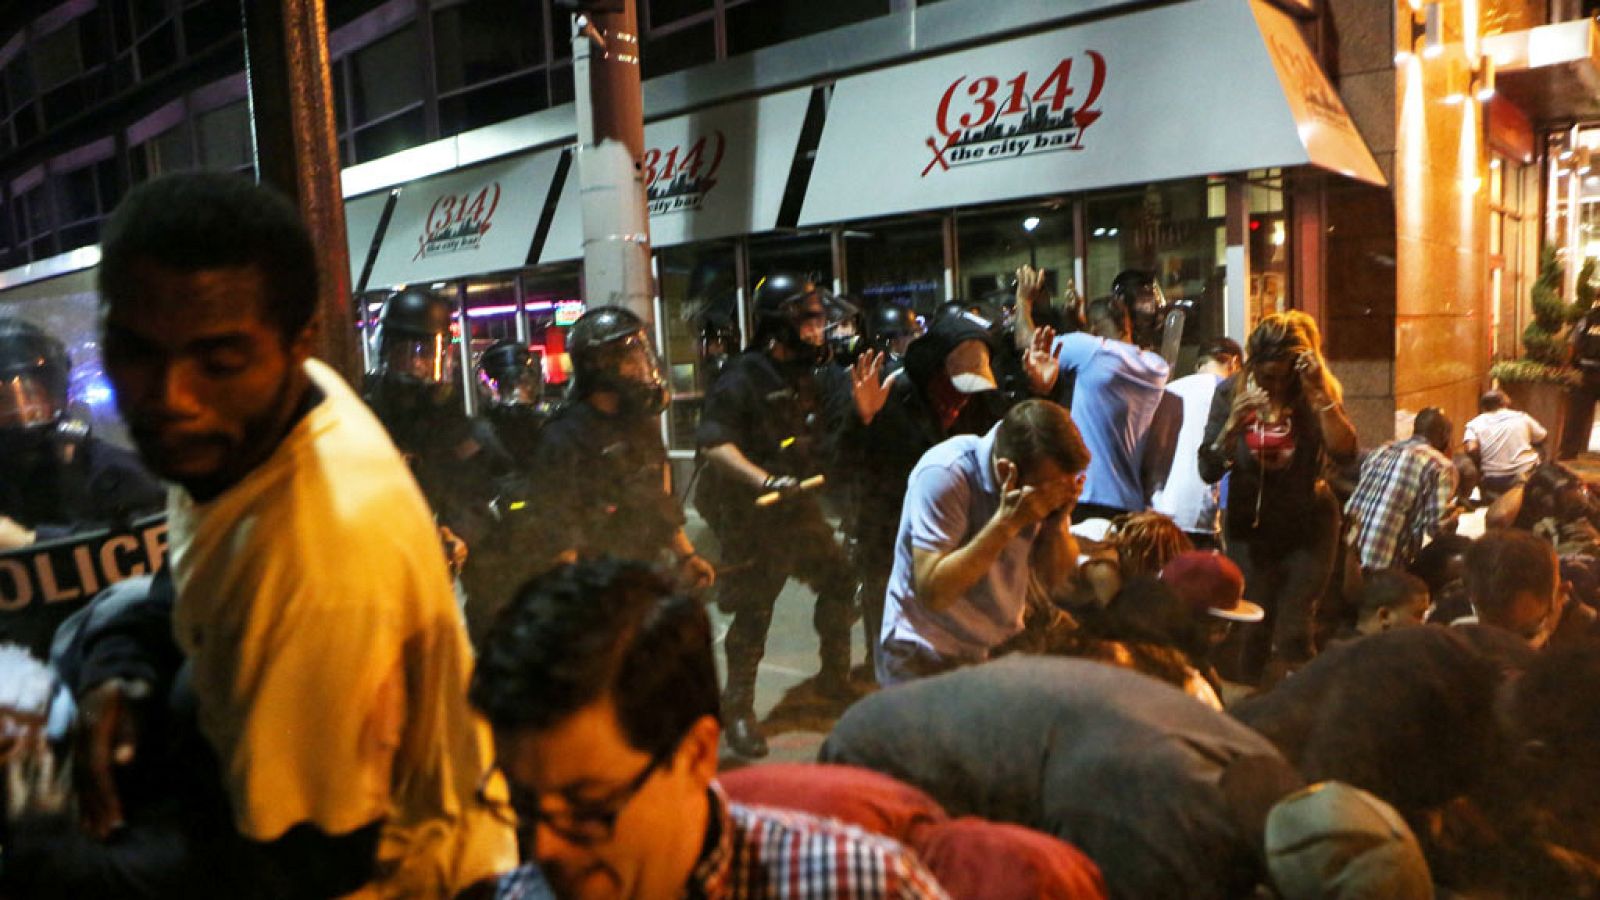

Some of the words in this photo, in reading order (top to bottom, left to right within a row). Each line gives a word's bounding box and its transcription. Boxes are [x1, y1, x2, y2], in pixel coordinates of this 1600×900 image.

[936, 50, 1107, 137] (314)
[644, 129, 725, 185] 314)
[950, 145, 983, 162] the
[988, 139, 1029, 156] city
[1035, 132, 1076, 149] bar
[426, 182, 501, 235] (314)
